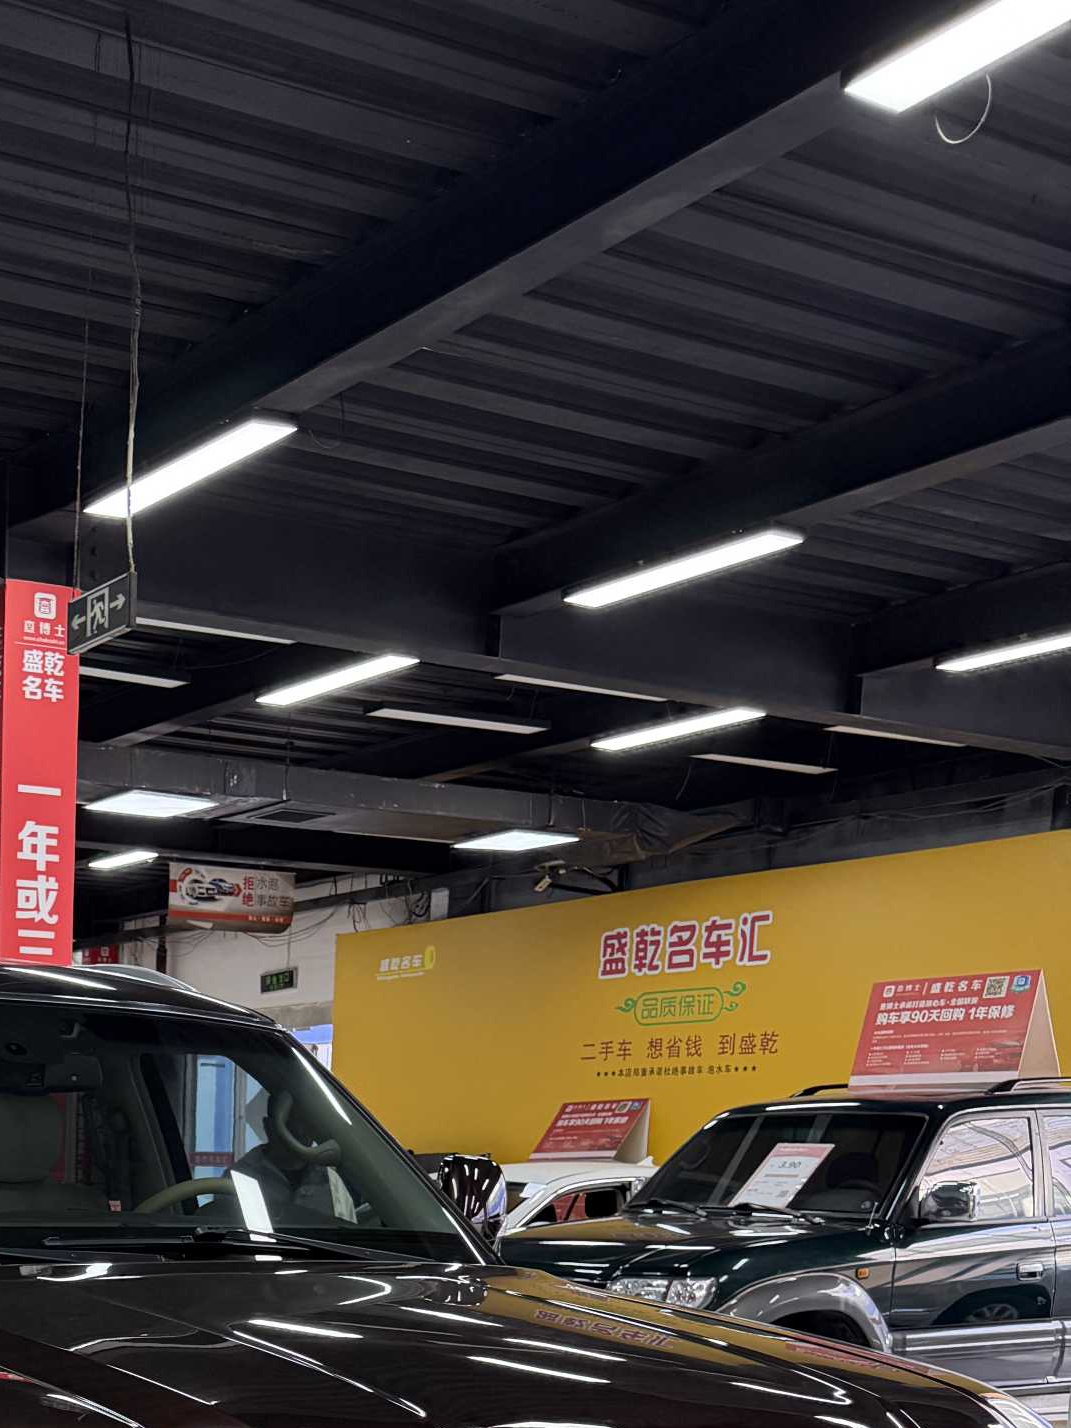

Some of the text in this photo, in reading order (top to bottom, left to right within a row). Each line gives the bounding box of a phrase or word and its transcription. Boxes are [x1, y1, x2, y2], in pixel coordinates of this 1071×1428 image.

[599, 911, 772, 978] 盛乾名车汇
[641, 993, 715, 1019] 品质保证
[875, 1004, 1016, 1026] 购车享90天回购 1年保修
[581, 1031, 779, 1061] 二手车 想省钱 到盛乾
